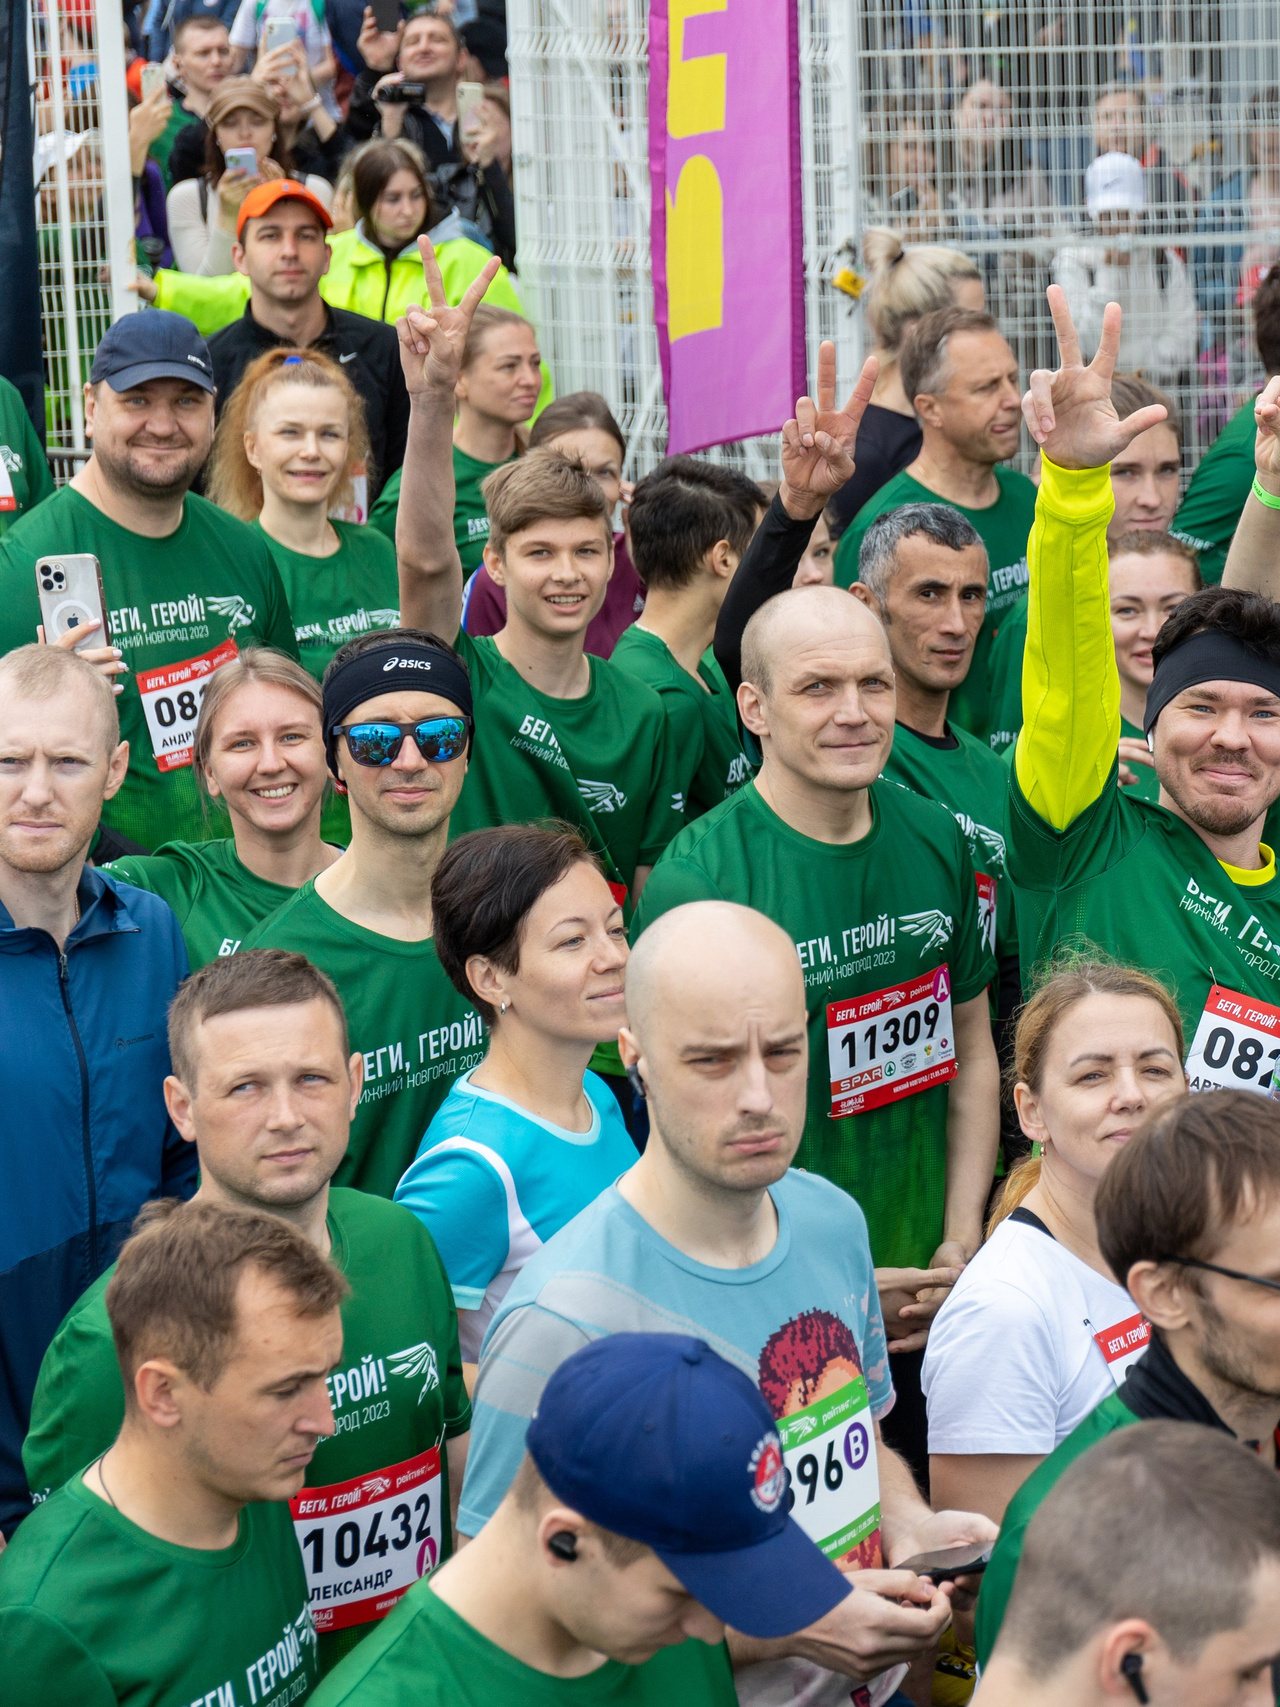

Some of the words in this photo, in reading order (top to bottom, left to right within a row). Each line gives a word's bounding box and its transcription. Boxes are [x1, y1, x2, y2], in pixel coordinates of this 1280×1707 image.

[992, 556, 1029, 593] ГЕРОЙ
[108, 606, 147, 634] ЕГИ,
[151, 593, 206, 627] ГЕРОЙ!
[328, 608, 371, 635] ГЕРОЙ!
[112, 633, 143, 650] ИЖНИЙ
[190, 625, 209, 639] 2023
[399, 659, 431, 671] asics
[154, 684, 207, 728] 08
[162, 730, 196, 748] АНДР
[796, 936, 838, 968] ЕГИ,
[842, 913, 895, 957] ГЕРОЙ!
[836, 954, 872, 980] НОВГОРОД
[873, 950, 895, 967] 2023
[836, 1008, 857, 1022] БЕГИ,
[859, 997, 883, 1016] ГЕРОЙ!
[1216, 998, 1242, 1018] БЕГИ,
[1244, 1007, 1278, 1029] ГЕРОЙ!
[363, 1042, 410, 1082] ЕГИ,
[419, 1011, 483, 1064] ГЕРОЙ!
[841, 1002, 939, 1068] 11309
[359, 1075, 403, 1104] ИЖНИЙ
[407, 1058, 456, 1088] НОВГОРОД
[840, 1069, 882, 1091] SPAR
[1108, 1336, 1129, 1354] БЕГИ,
[1126, 1323, 1149, 1346] ГЕРОЙ!
[362, 1400, 390, 1424] 2023
[299, 1499, 328, 1514] БЕГИ,
[331, 1486, 362, 1510] ГЕРОЙ!
[303, 1493, 431, 1575] 10432
[310, 1568, 393, 1601] ЛЕКСАНДР
[246, 1622, 303, 1706] ГЕРОЙ!
